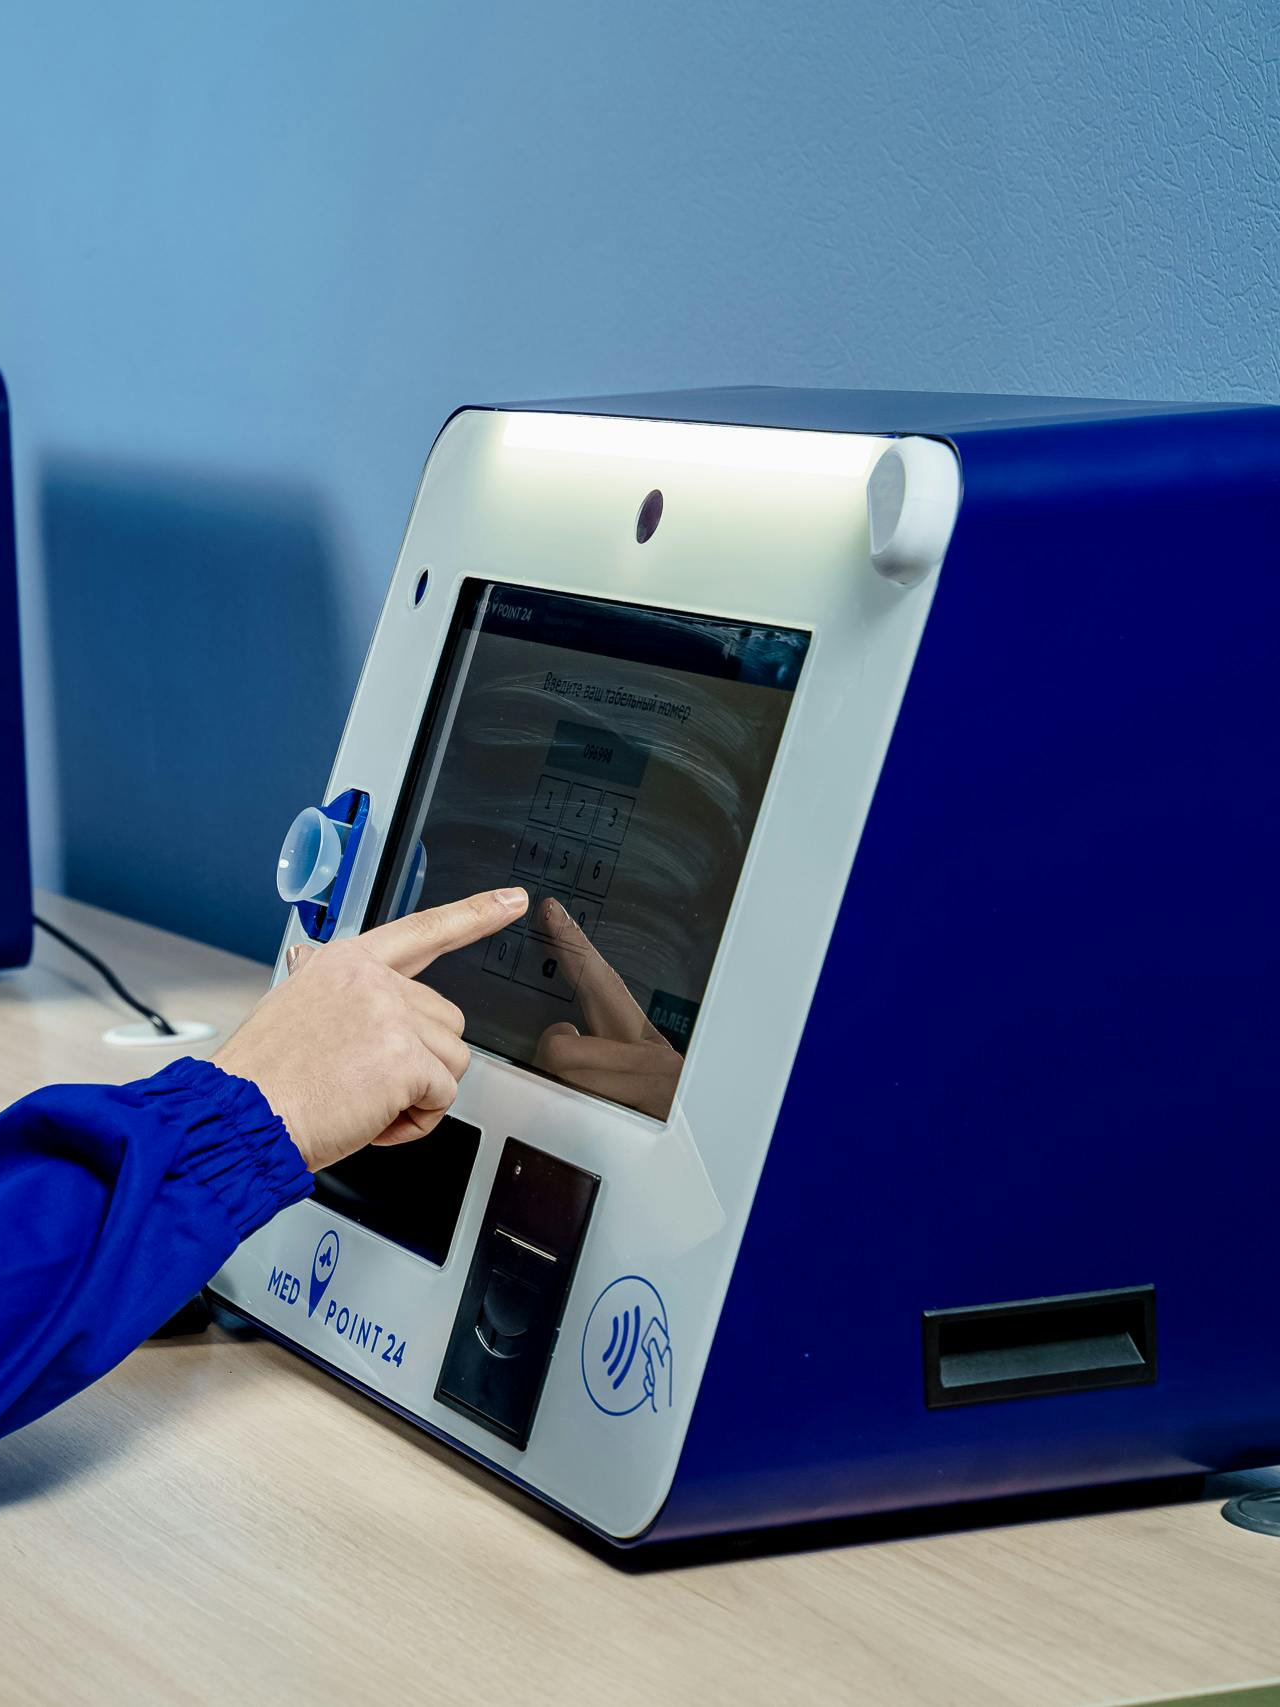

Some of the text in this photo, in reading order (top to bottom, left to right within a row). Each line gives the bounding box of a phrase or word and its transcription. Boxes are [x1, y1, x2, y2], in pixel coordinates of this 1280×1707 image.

[497, 603, 522, 620] POINT
[521, 607, 533, 622] 24
[543, 672, 691, 723] Введите ваш табельный номер
[544, 791, 618, 827] 1 2 3
[529, 841, 602, 880] 4 5 6
[498, 942, 507, 961] 0
[650, 1006, 690, 1034] ДАЛЕЕ
[267, 1266, 407, 1368] MED POINT 24
